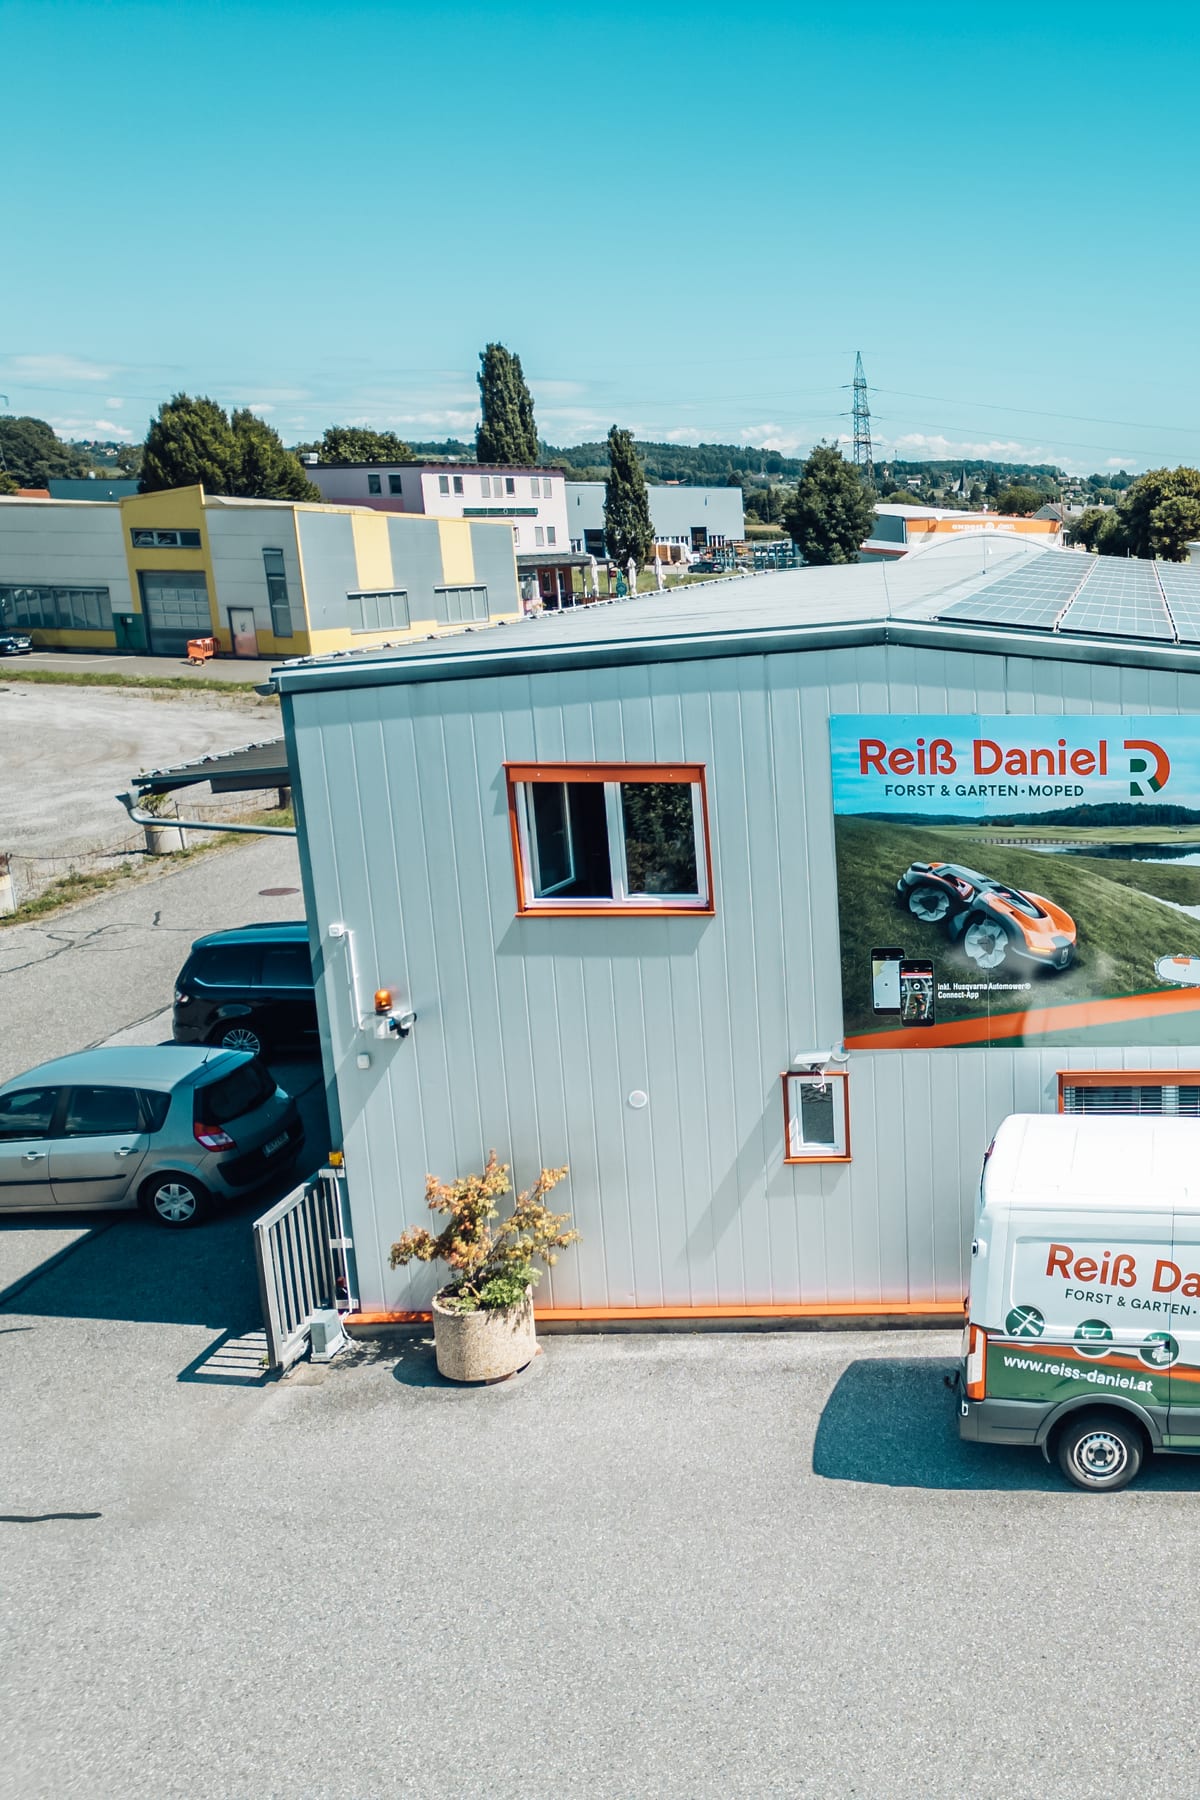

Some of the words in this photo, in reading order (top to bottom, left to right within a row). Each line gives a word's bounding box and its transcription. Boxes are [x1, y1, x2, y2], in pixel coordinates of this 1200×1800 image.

[858, 737, 957, 776] Reiß
[972, 738, 1107, 776] Daniel
[885, 784, 936, 797] FORST
[940, 784, 951, 797] &
[937, 991, 980, 1000] Connect-App
[953, 983, 987, 992] Husqvarna
[1045, 1243, 1138, 1288] Reiß
[1065, 1288, 1113, 1305] FORST
[1117, 1296, 1127, 1308] &
[1003, 1356, 1154, 1392] www.reiss-daniel.at
